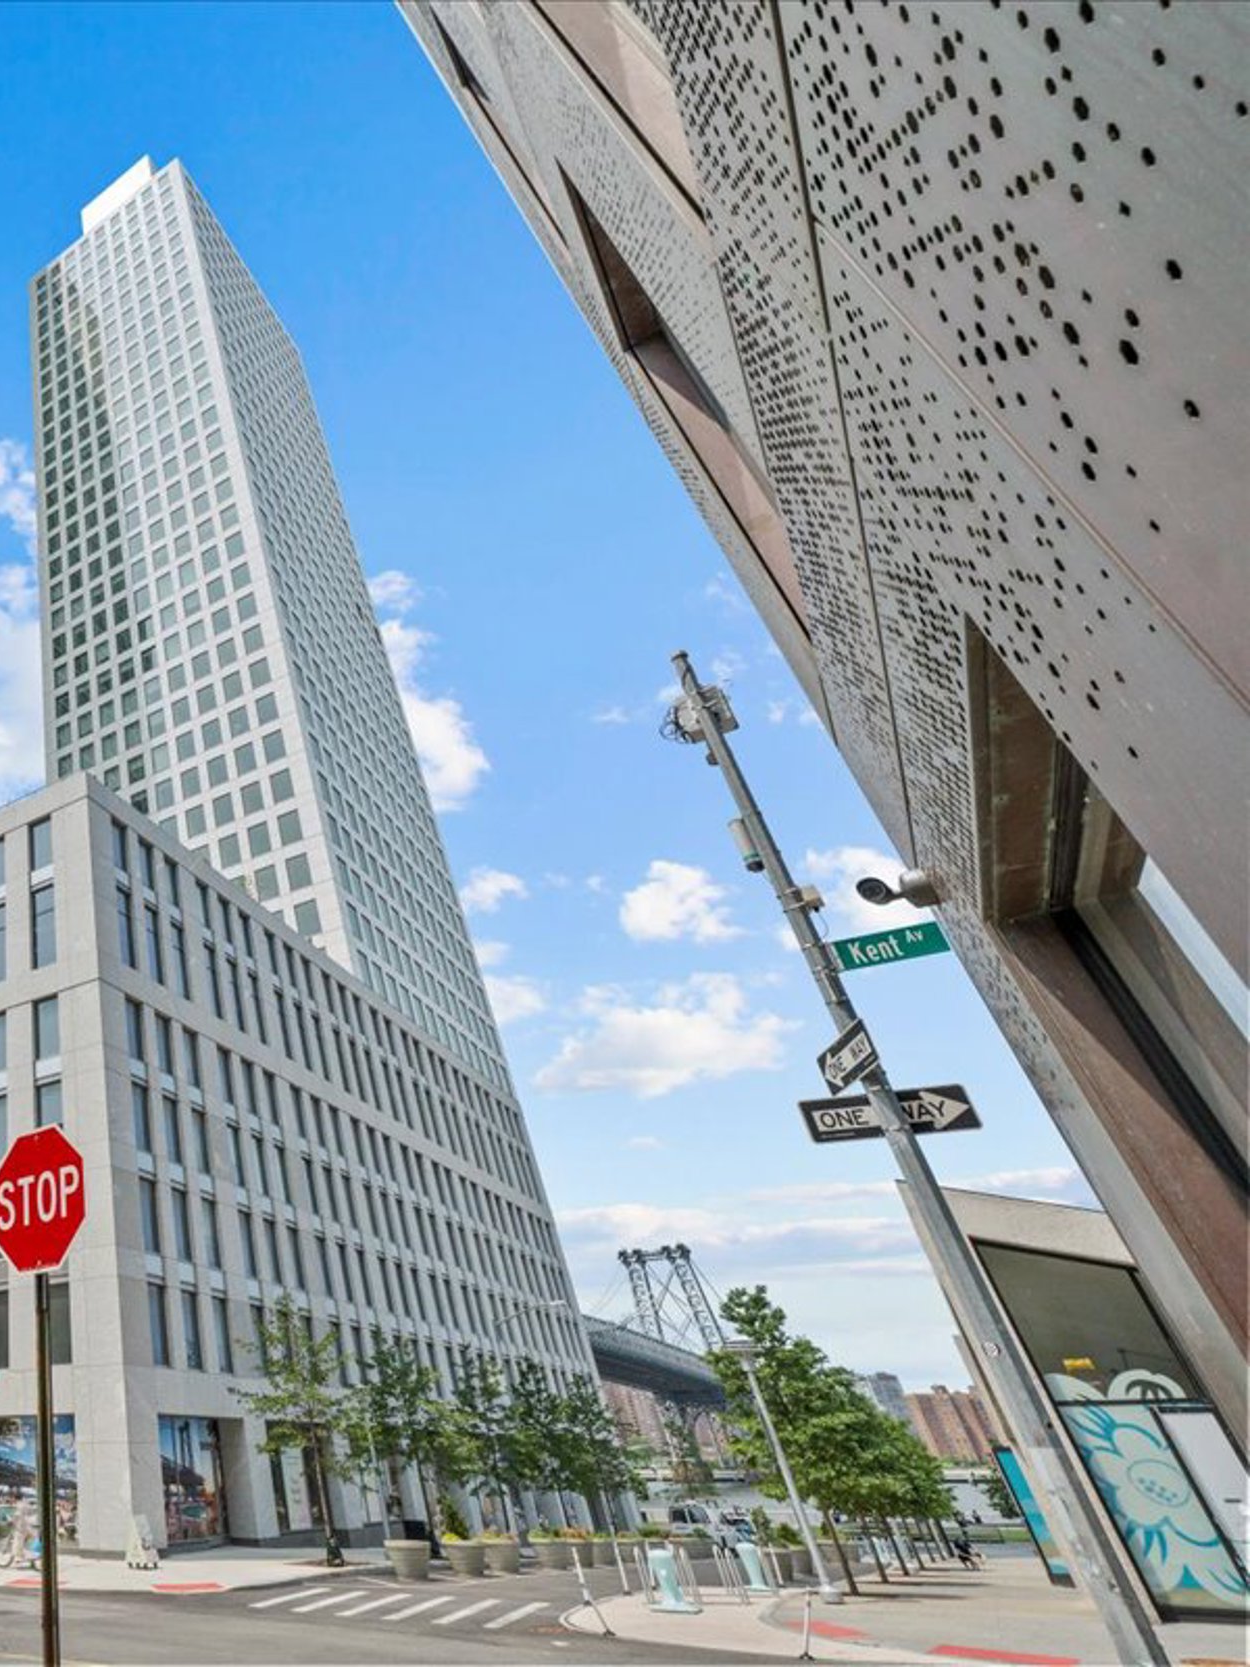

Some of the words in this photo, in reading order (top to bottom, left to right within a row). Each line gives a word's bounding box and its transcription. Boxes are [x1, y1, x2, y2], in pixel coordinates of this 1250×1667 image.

[848, 935, 904, 965] Kent
[905, 930, 923, 943] Av
[828, 1055, 847, 1080] ONE
[850, 1034, 868, 1060] WAY
[820, 1108, 869, 1128] ONE
